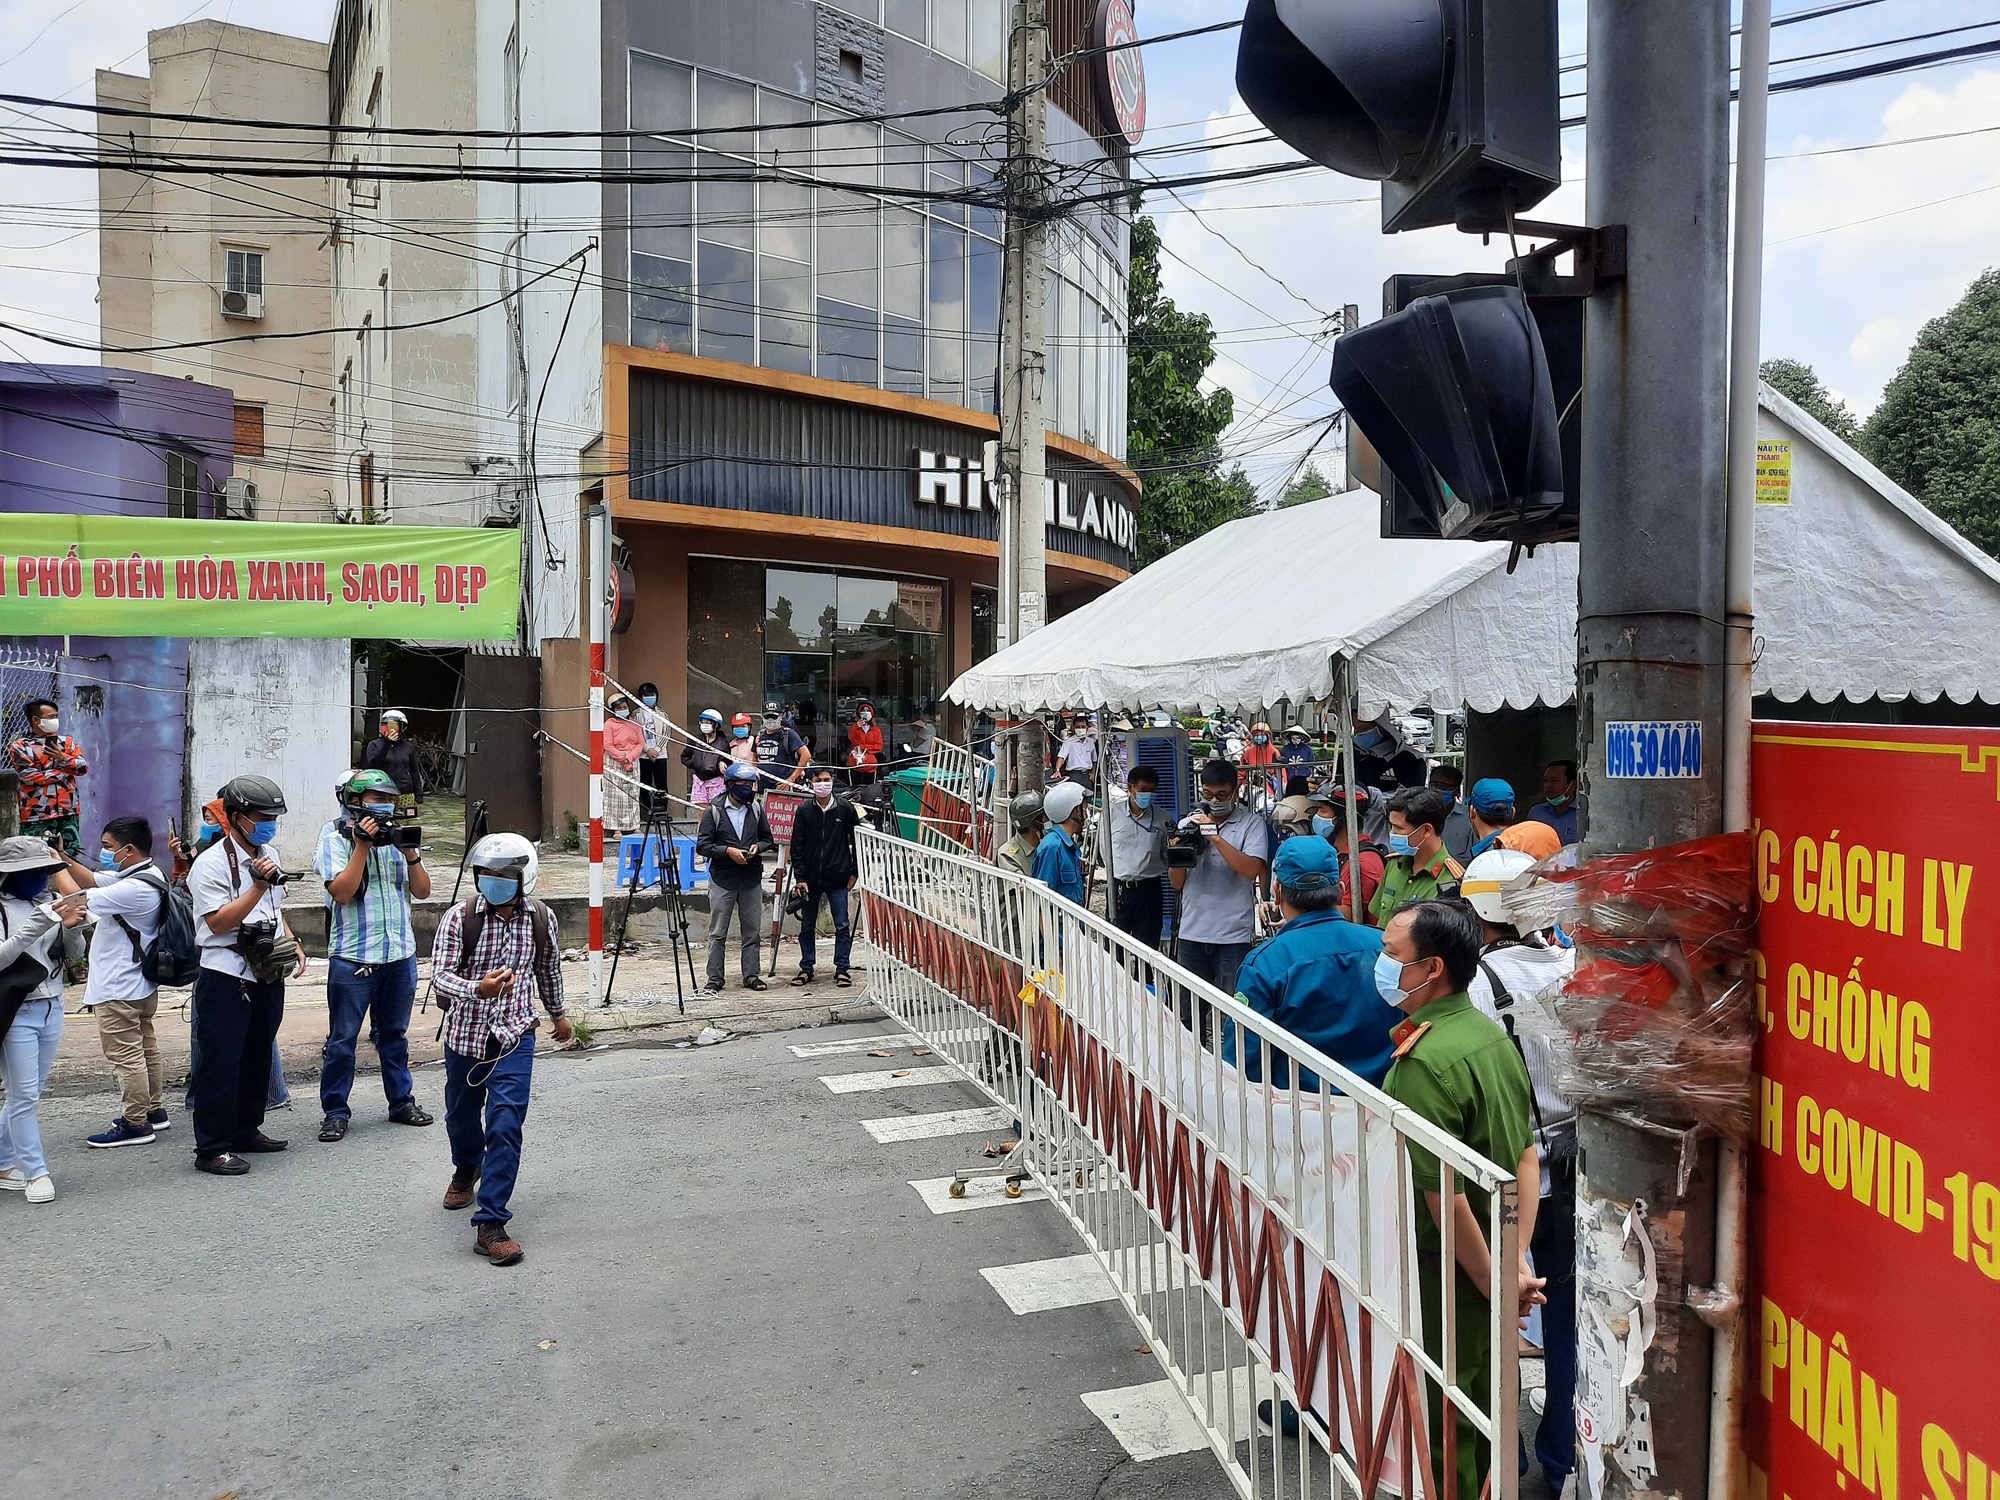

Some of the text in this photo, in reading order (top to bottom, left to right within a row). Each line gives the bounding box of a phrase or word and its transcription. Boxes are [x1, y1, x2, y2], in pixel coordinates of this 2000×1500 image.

[919, 450, 1135, 553] HILANDS
[17, 544, 82, 598] PHỐ
[93, 552, 165, 599] BIÊN
[175, 554, 239, 601] HÒA
[246, 560, 333, 606] XANH,
[341, 562, 426, 610] SẠCH,
[434, 564, 487, 611] ĐẸP
[1608, 728, 1700, 777] 0916.30.40.40
[1755, 818, 1974, 952] C CÁCH LY
[1787, 956, 1931, 1092] CHỐNG
[1760, 1074, 2000, 1281] H COVID-19
[1760, 1294, 1898, 1500] PHẬN
